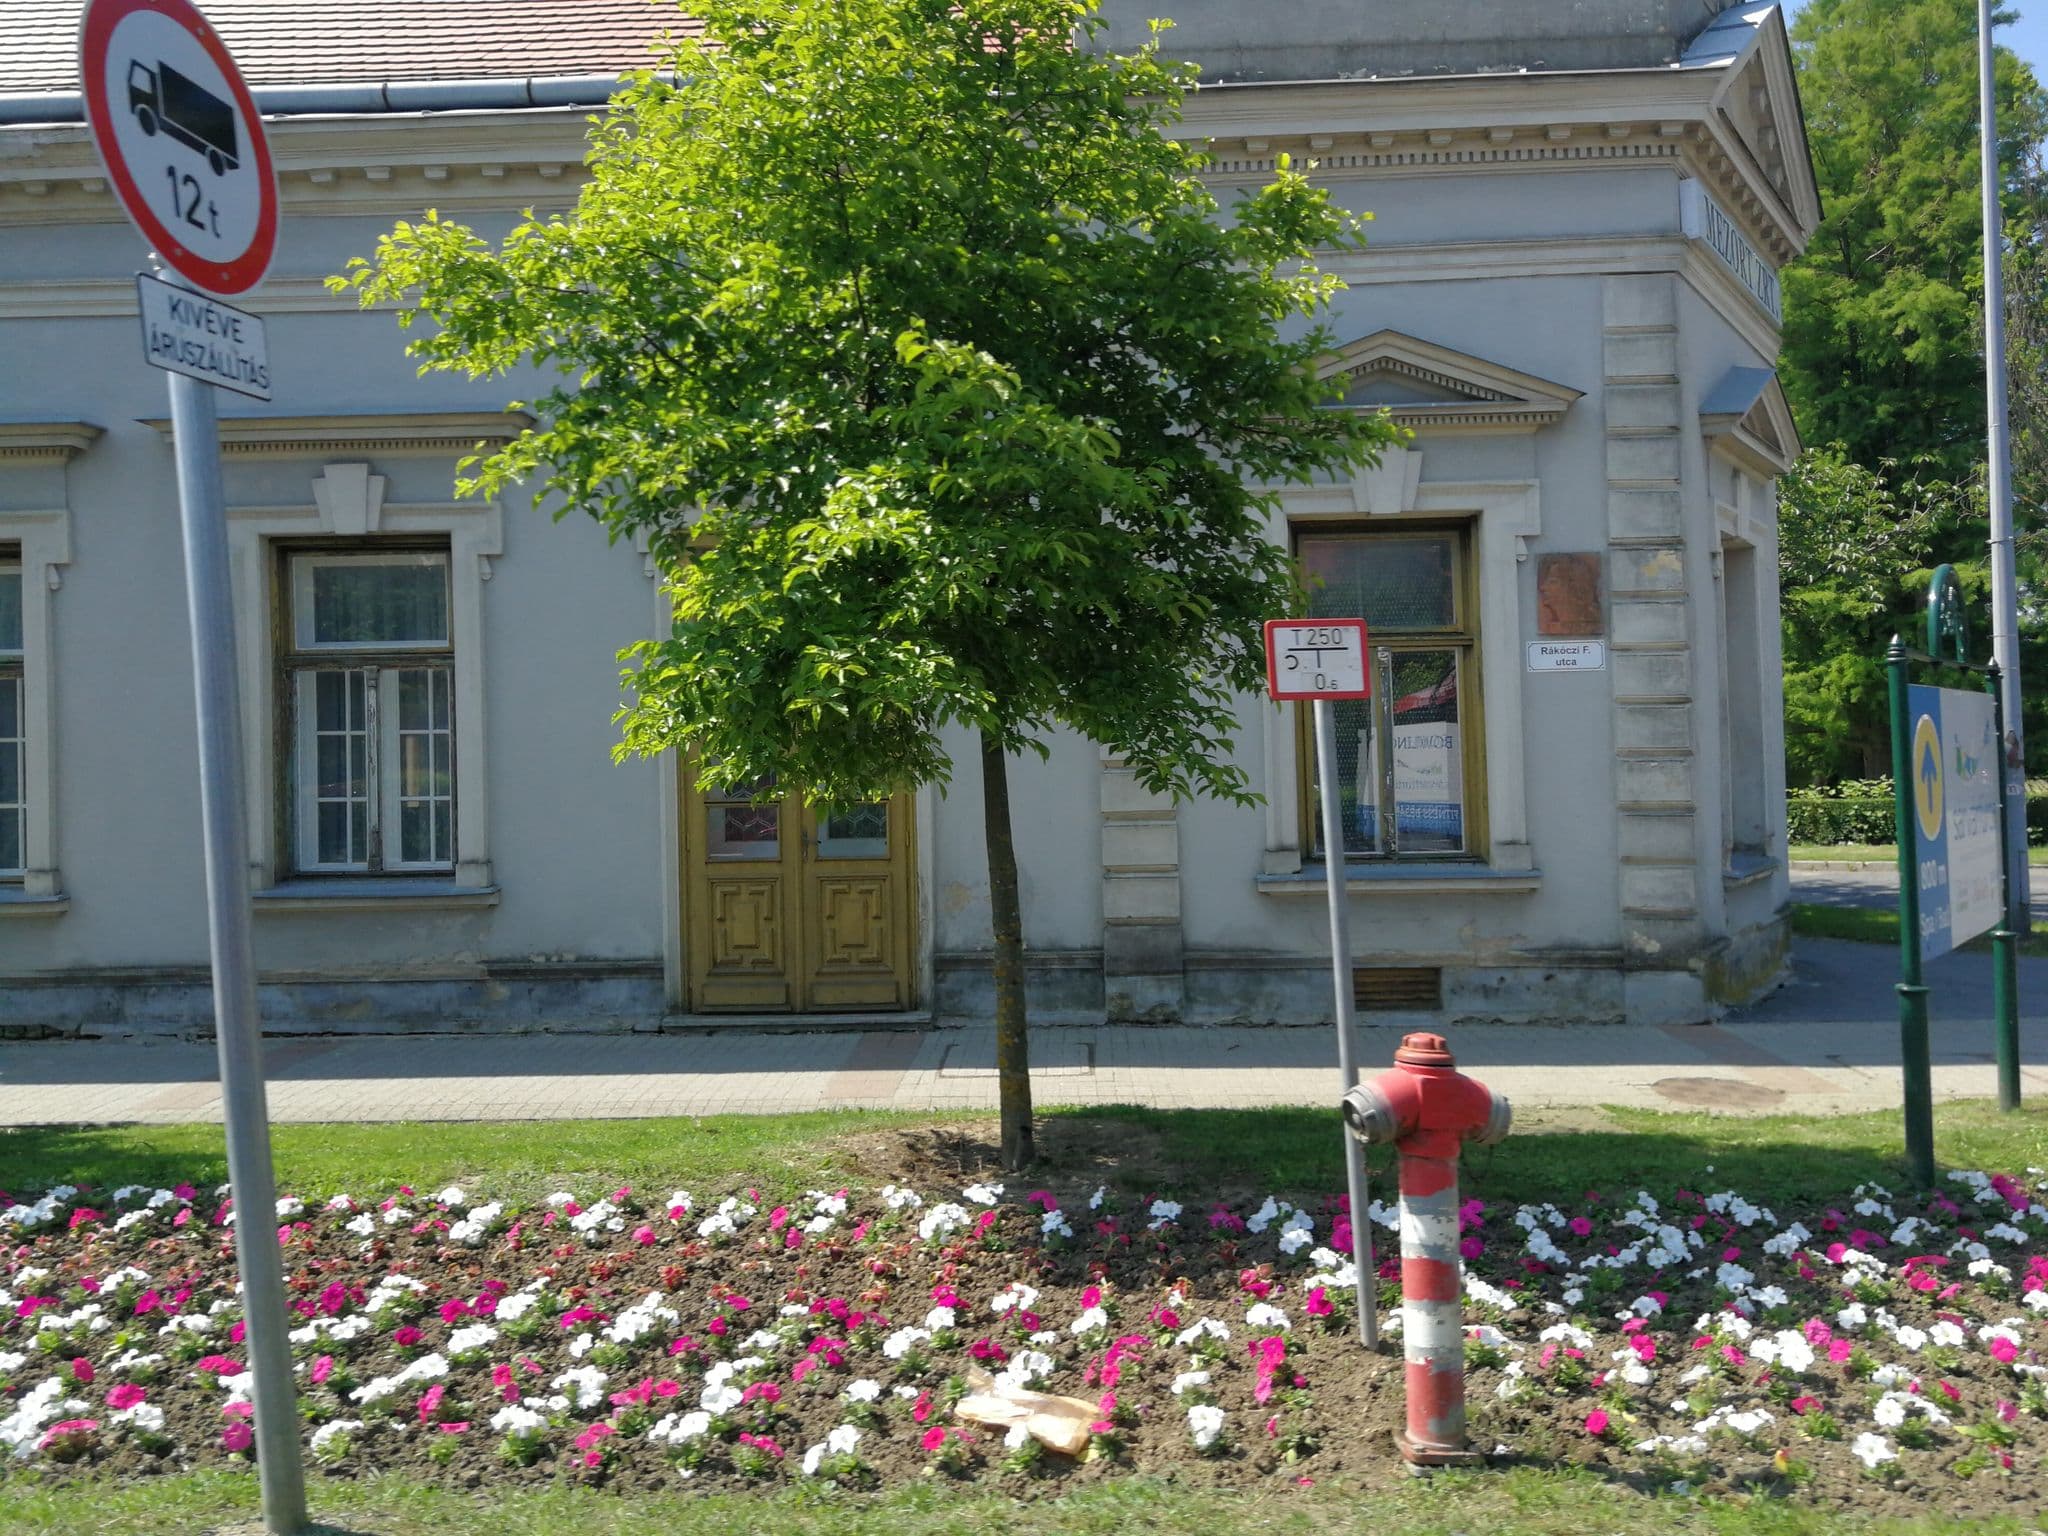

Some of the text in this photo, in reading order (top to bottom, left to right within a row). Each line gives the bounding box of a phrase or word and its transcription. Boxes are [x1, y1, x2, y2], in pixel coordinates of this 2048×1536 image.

[168, 295, 244, 343] KIVÉVE
[151, 323, 270, 389] ÁRUSZÁLLÍTÁS
[1541, 647, 1580, 655] Rákóczi
[1555, 657, 1577, 667] utca
